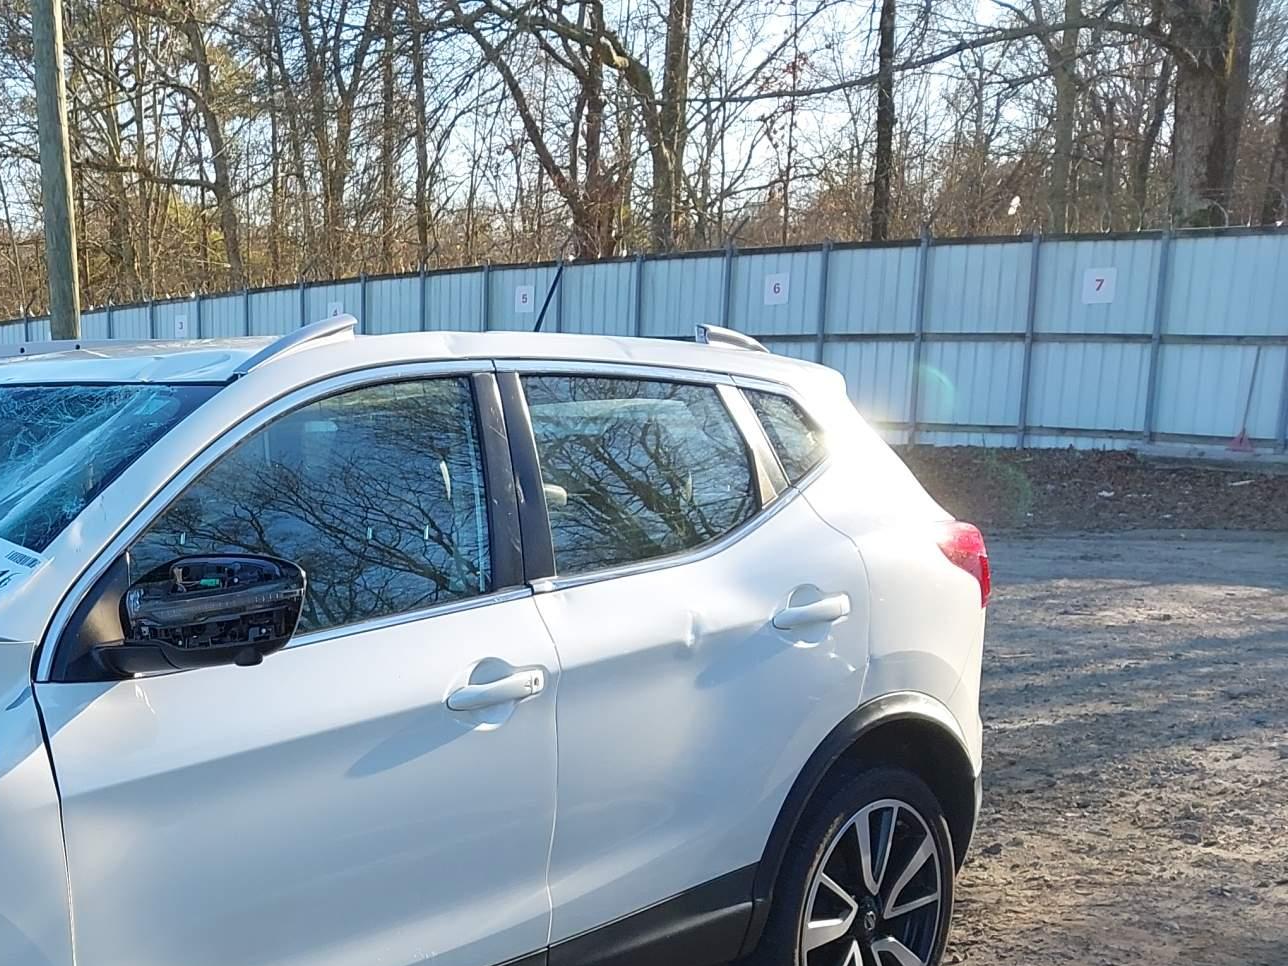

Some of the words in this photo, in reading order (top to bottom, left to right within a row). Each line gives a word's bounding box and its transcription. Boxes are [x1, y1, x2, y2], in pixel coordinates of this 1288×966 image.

[773, 282, 781, 294] 6
[1095, 278, 1105, 291] 7
[521, 293, 528, 304] 5
